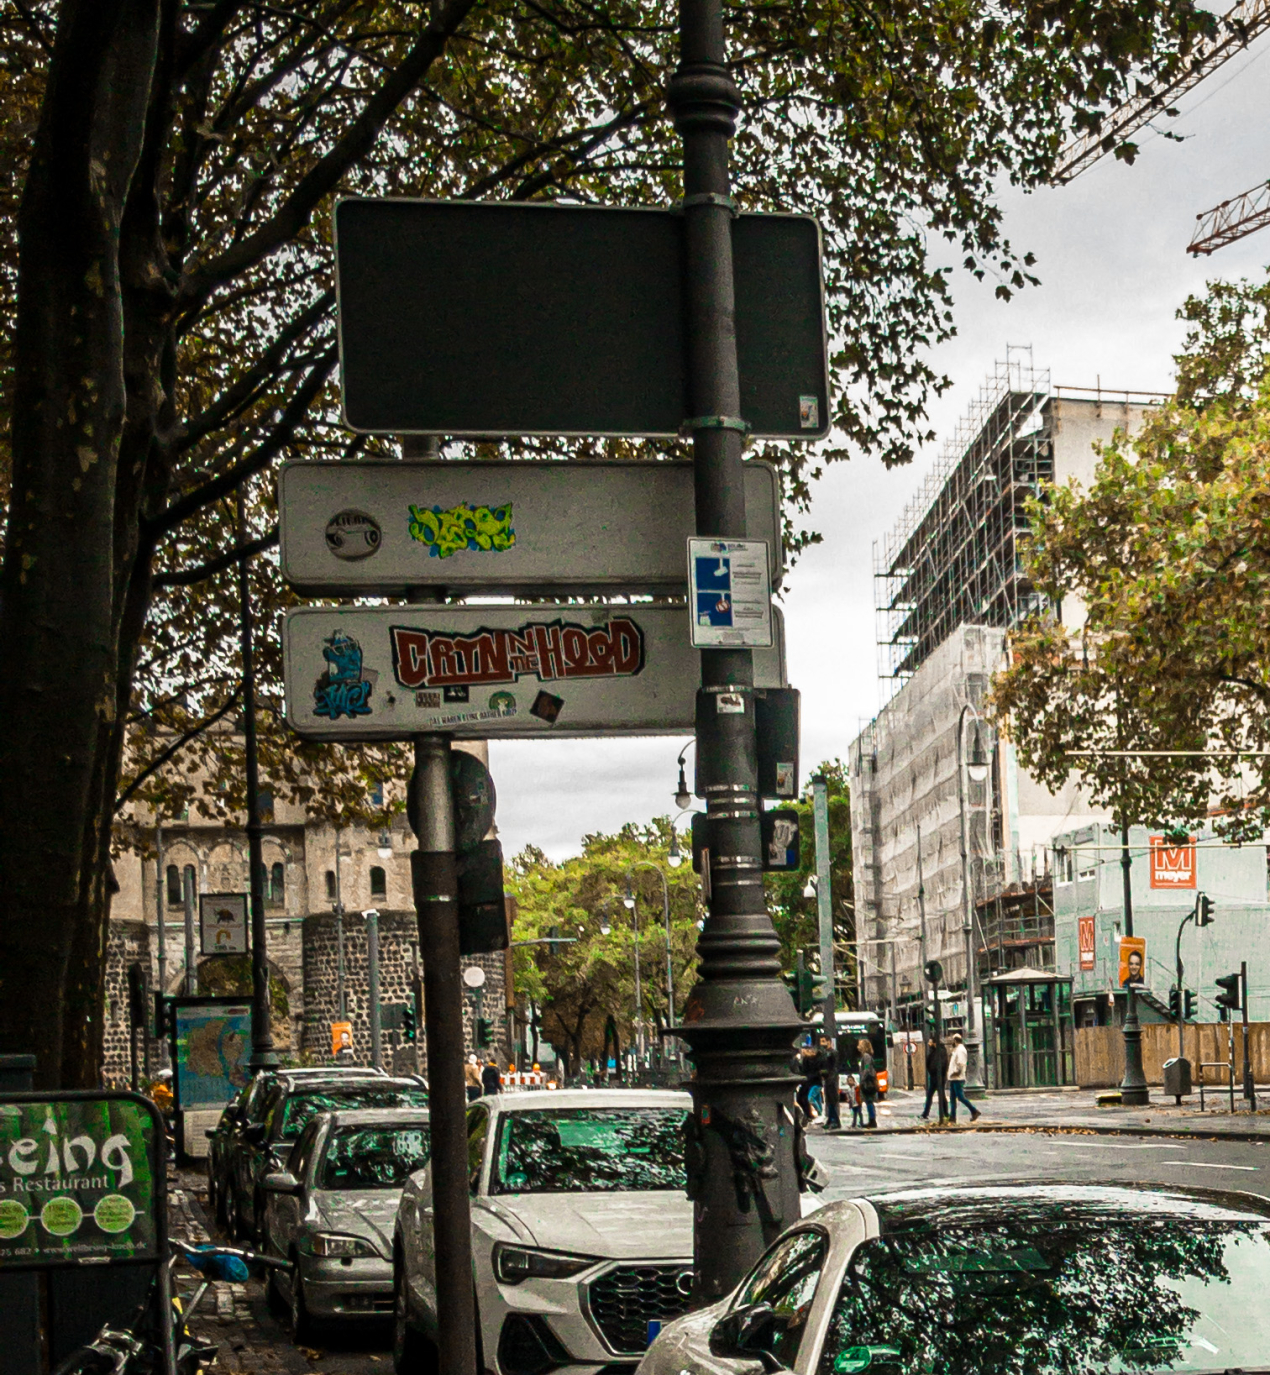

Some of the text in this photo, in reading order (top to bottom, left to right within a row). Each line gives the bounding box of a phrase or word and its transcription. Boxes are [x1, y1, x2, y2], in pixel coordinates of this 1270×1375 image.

[533, 619, 641, 679] HOOD
[1154, 871, 1192, 882] meyer
[0, 1117, 134, 1189] eing
[13, 1175, 109, 1192] Restaurant
